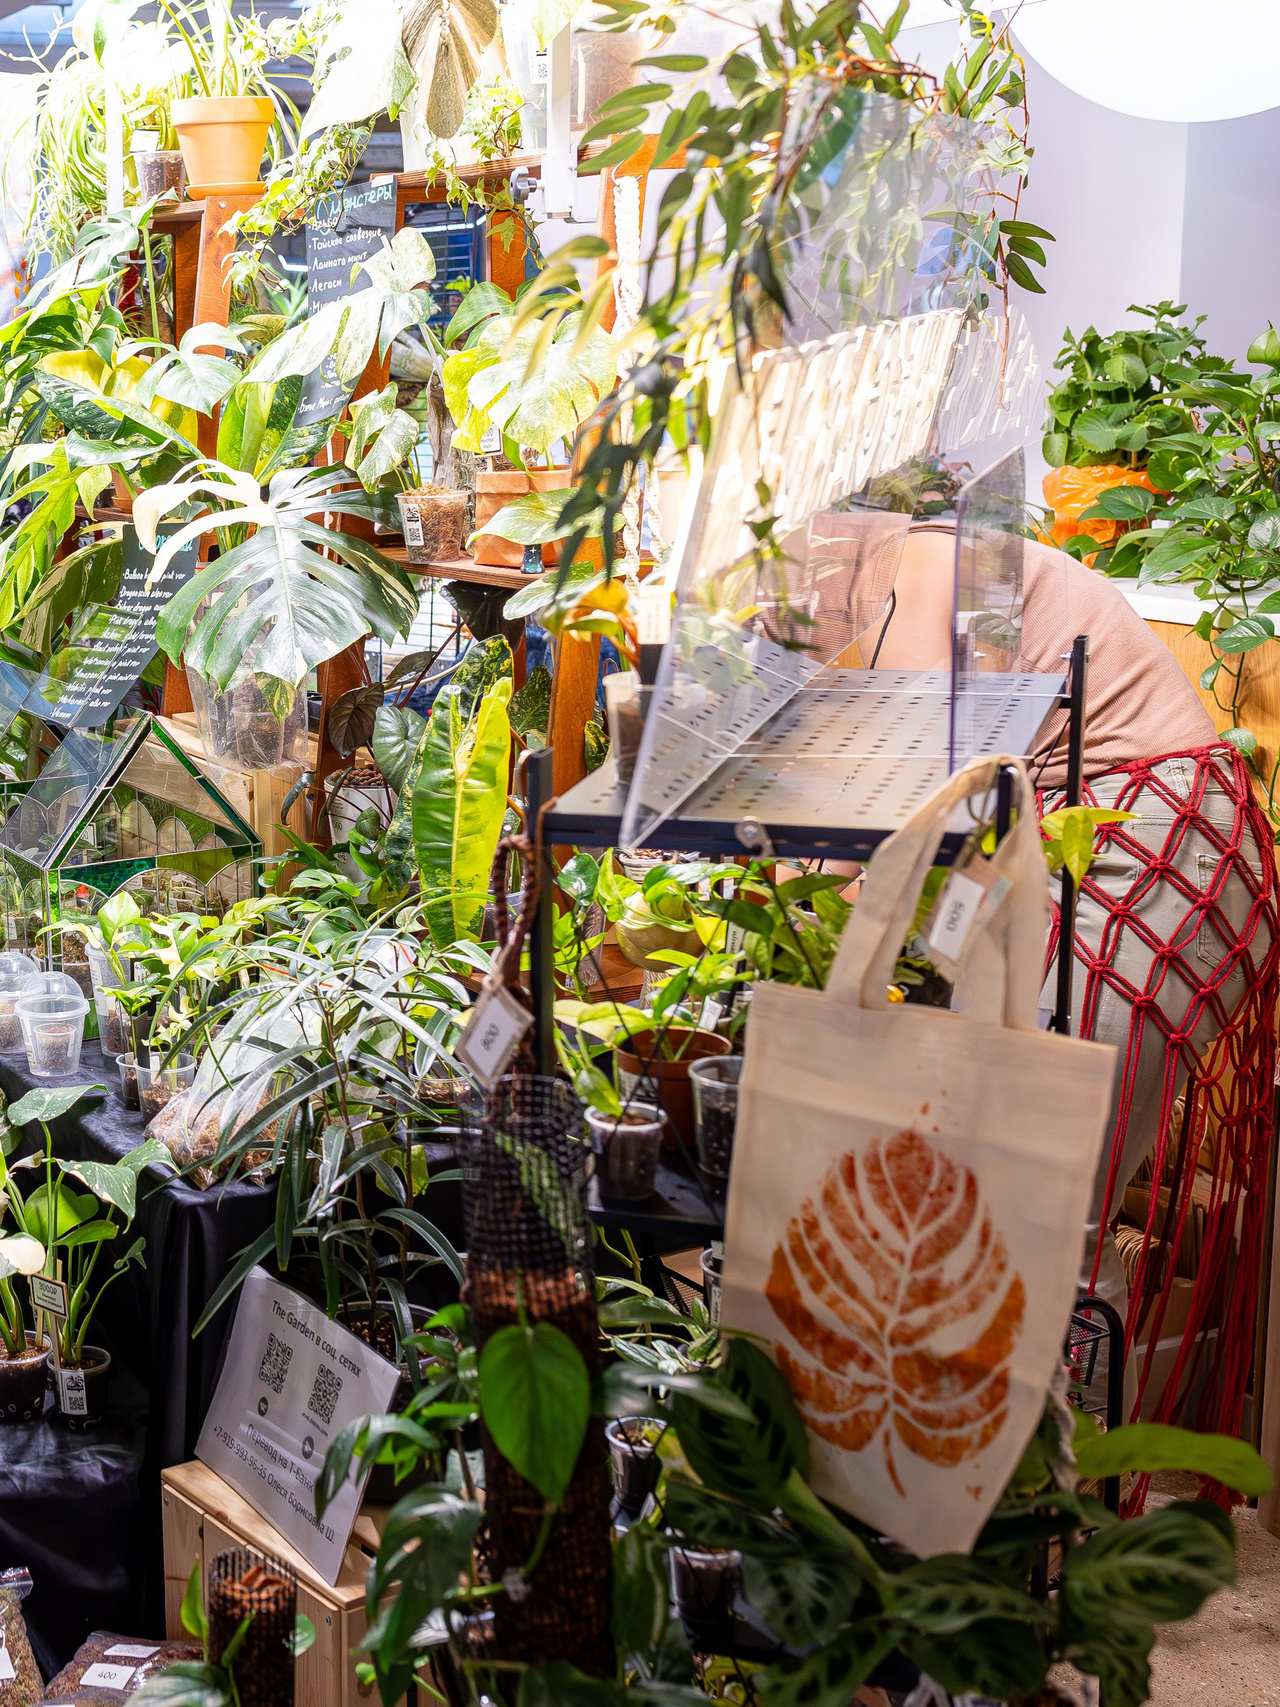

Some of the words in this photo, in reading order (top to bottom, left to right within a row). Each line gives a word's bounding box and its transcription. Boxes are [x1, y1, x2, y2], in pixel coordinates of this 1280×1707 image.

[272, 1299, 287, 1320] The
[286, 1311, 315, 1342] Garden
[315, 1335, 322, 1346] в
[321, 1341, 337, 1361] соц.
[338, 1354, 362, 1378] сетях
[213, 1425, 268, 1480] +7-919-993-96-35
[267, 1473, 288, 1500] Олеся
[246, 1423, 278, 1462] Перевод
[278, 1453, 288, 1470] на
[97, 1670, 118, 1681] 400
